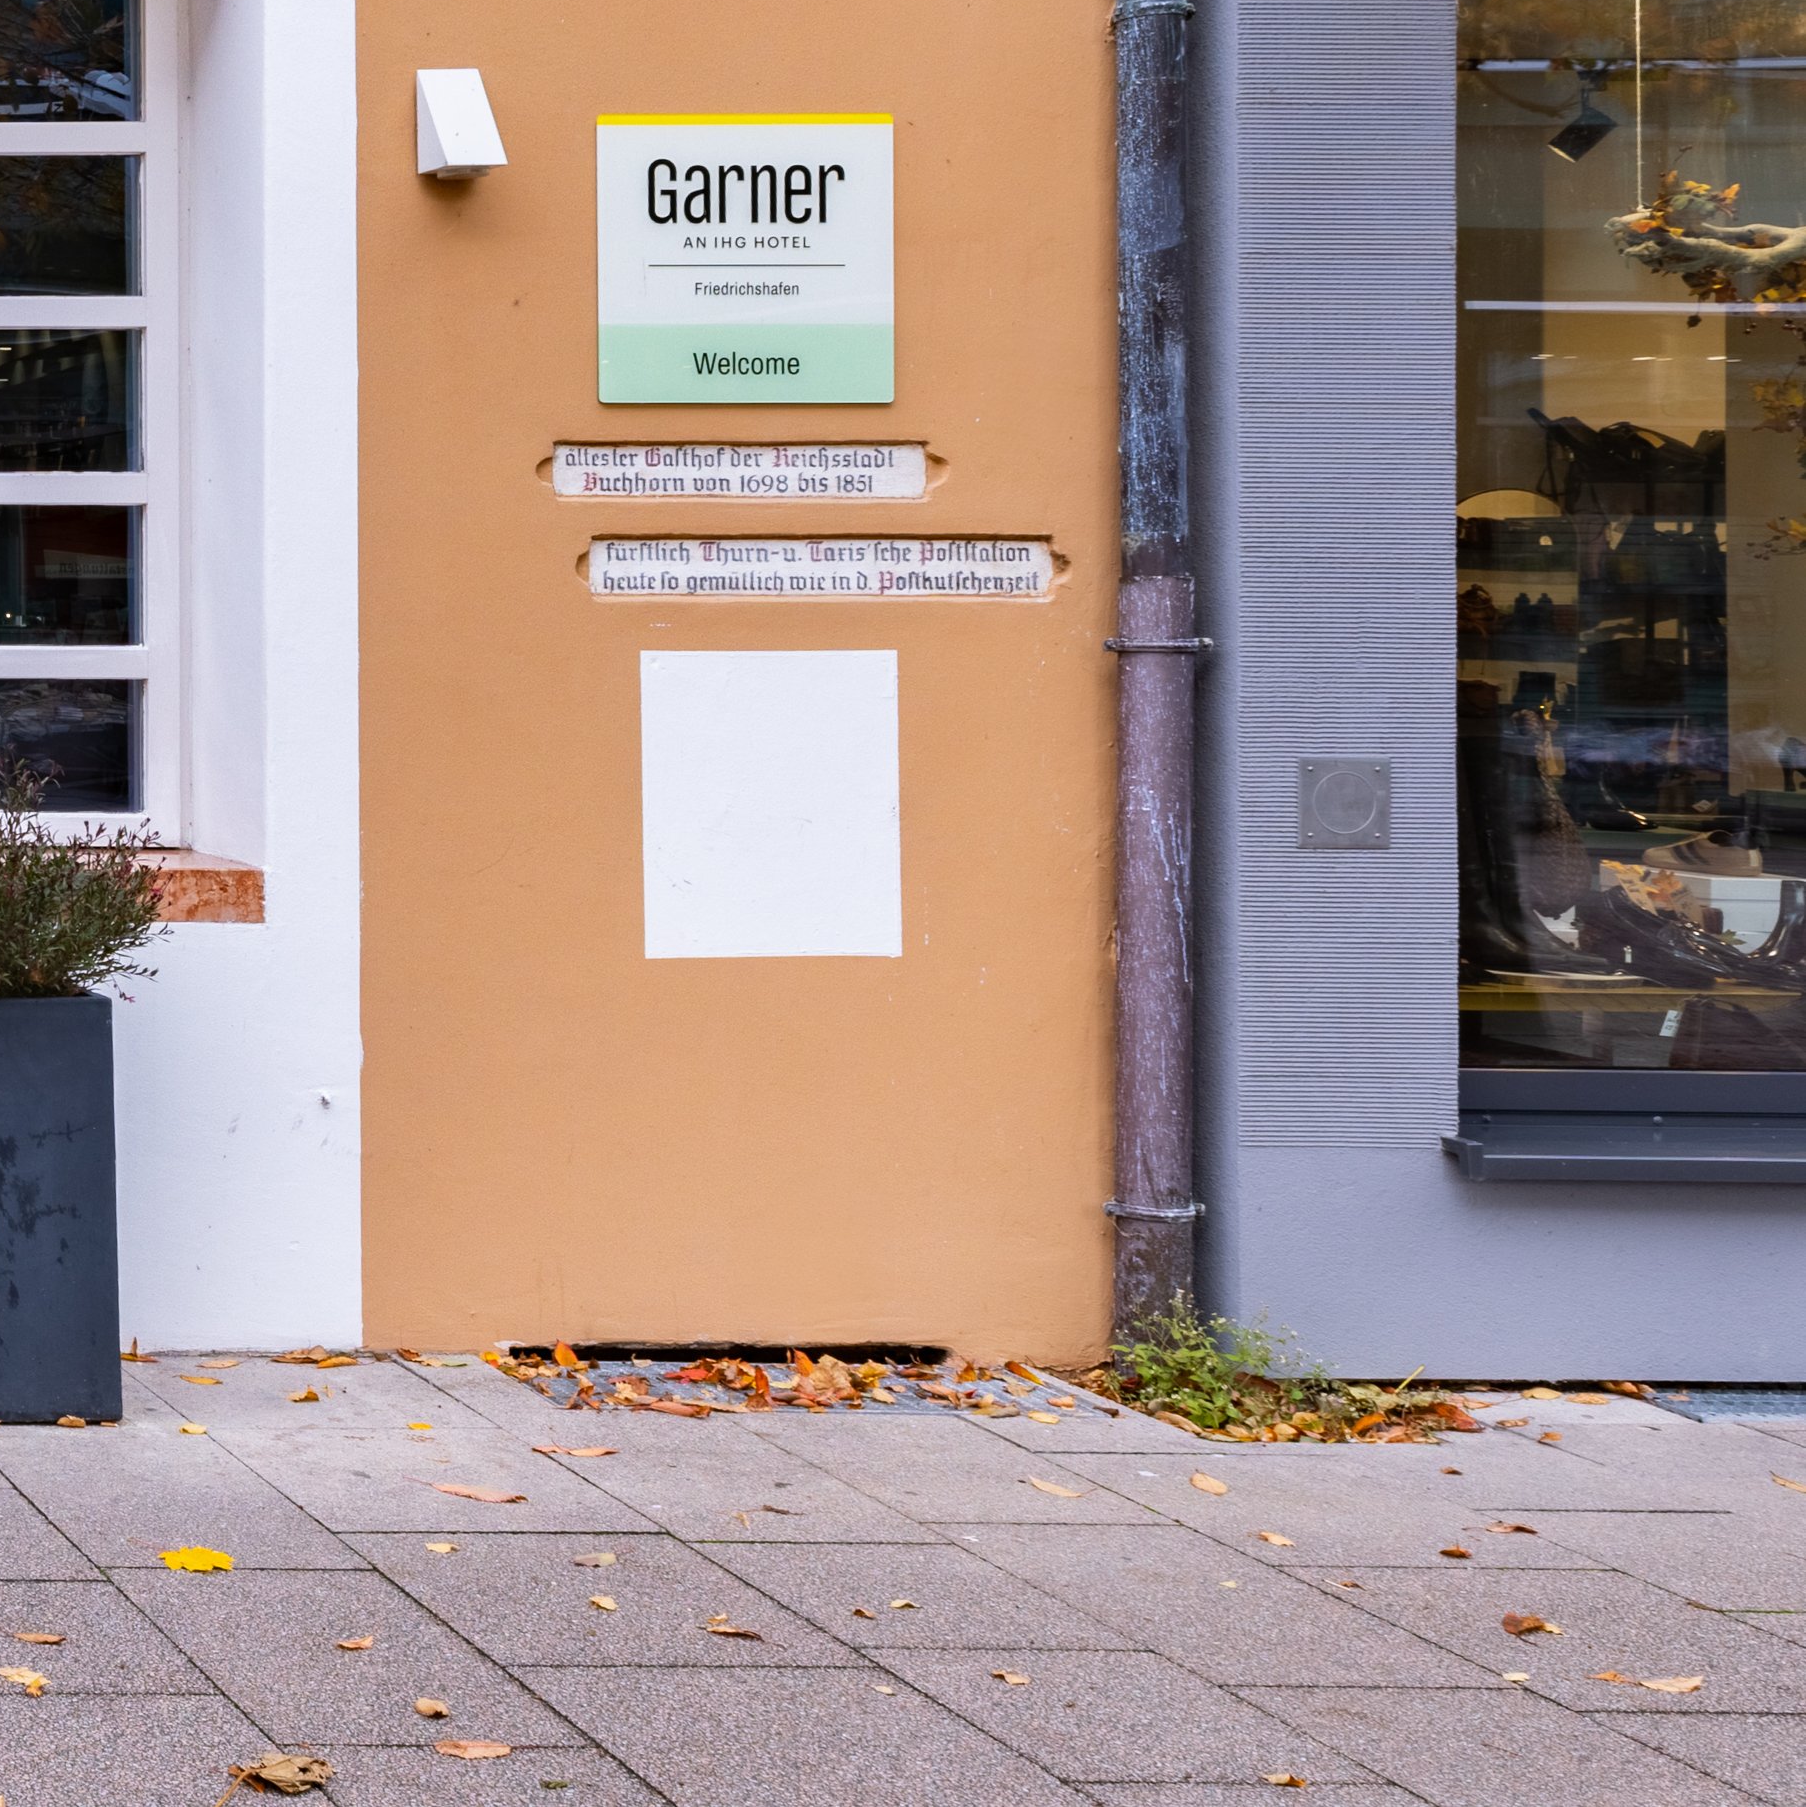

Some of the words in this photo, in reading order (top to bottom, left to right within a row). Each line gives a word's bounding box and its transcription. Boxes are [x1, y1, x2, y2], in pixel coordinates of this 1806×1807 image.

[647, 158, 845, 225] Garner
[683, 236, 706, 249] AN
[714, 236, 747, 249] IHG
[754, 236, 811, 249] HOTEL
[694, 282, 799, 295] Friedrichshafen
[693, 351, 800, 375] Welcome
[565, 447, 638, 467] ältester
[730, 447, 763, 467] der
[772, 446, 895, 471] Reichsstadt
[583, 472, 685, 494] Buchhorn
[692, 477, 731, 493] von
[740, 474, 789, 493] 1698
[798, 472, 829, 493] bis
[836, 474, 873, 493] 1851
[603, 570, 656, 594] heute
[686, 570, 784, 594] gemütlich
[789, 572, 826, 592] wie
[832, 571, 851, 592] in
